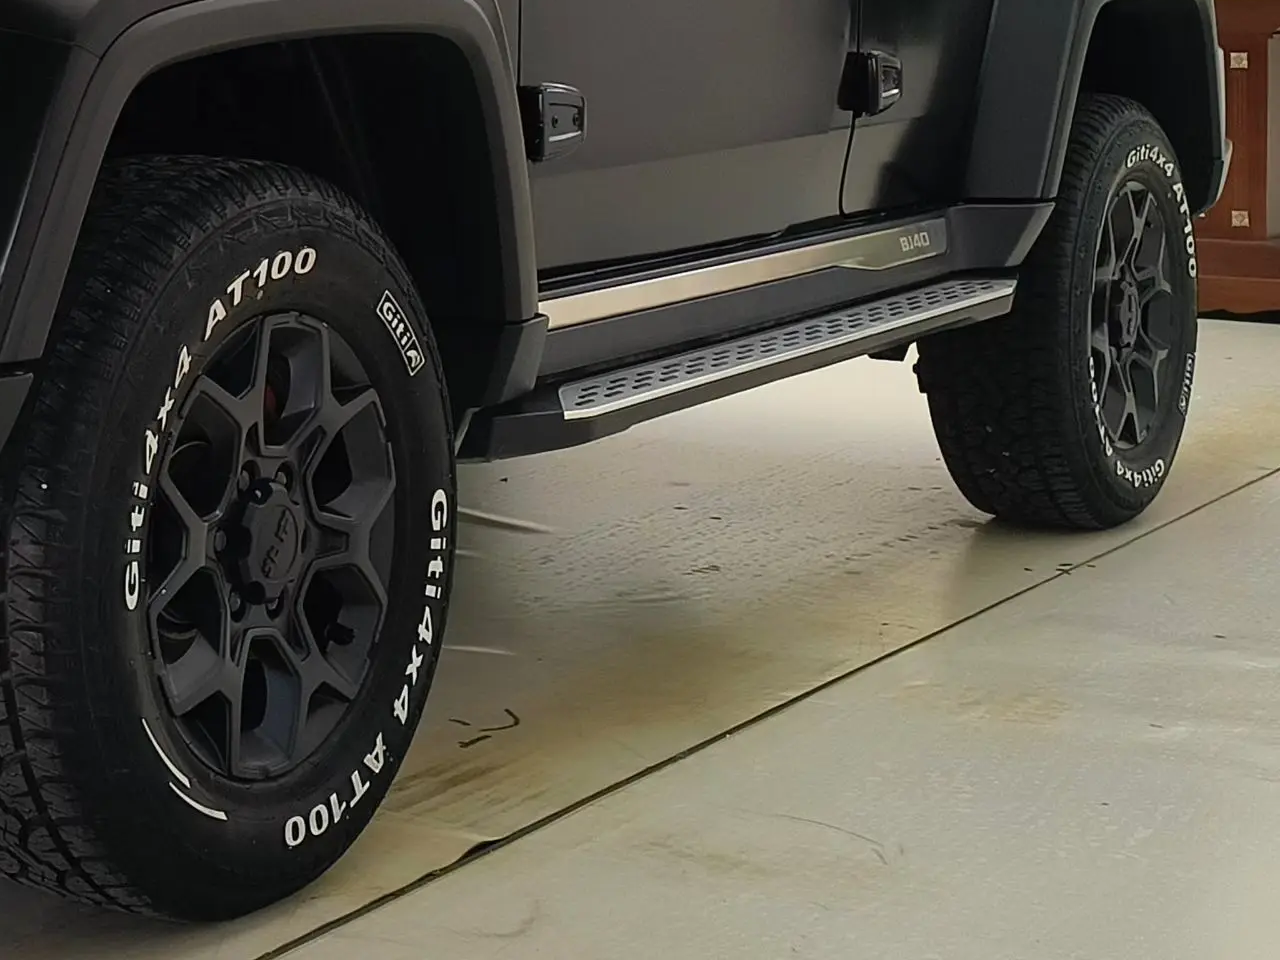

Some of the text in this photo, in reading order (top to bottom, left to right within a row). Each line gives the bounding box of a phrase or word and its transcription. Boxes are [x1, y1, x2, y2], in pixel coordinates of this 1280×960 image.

[1125, 143, 1175, 177] Giti4x4
[899, 231, 931, 252] BJ40
[203, 246, 318, 341] AT100
[381, 300, 410, 349] Giti
[283, 488, 449, 847] Giti4x4 AT100
